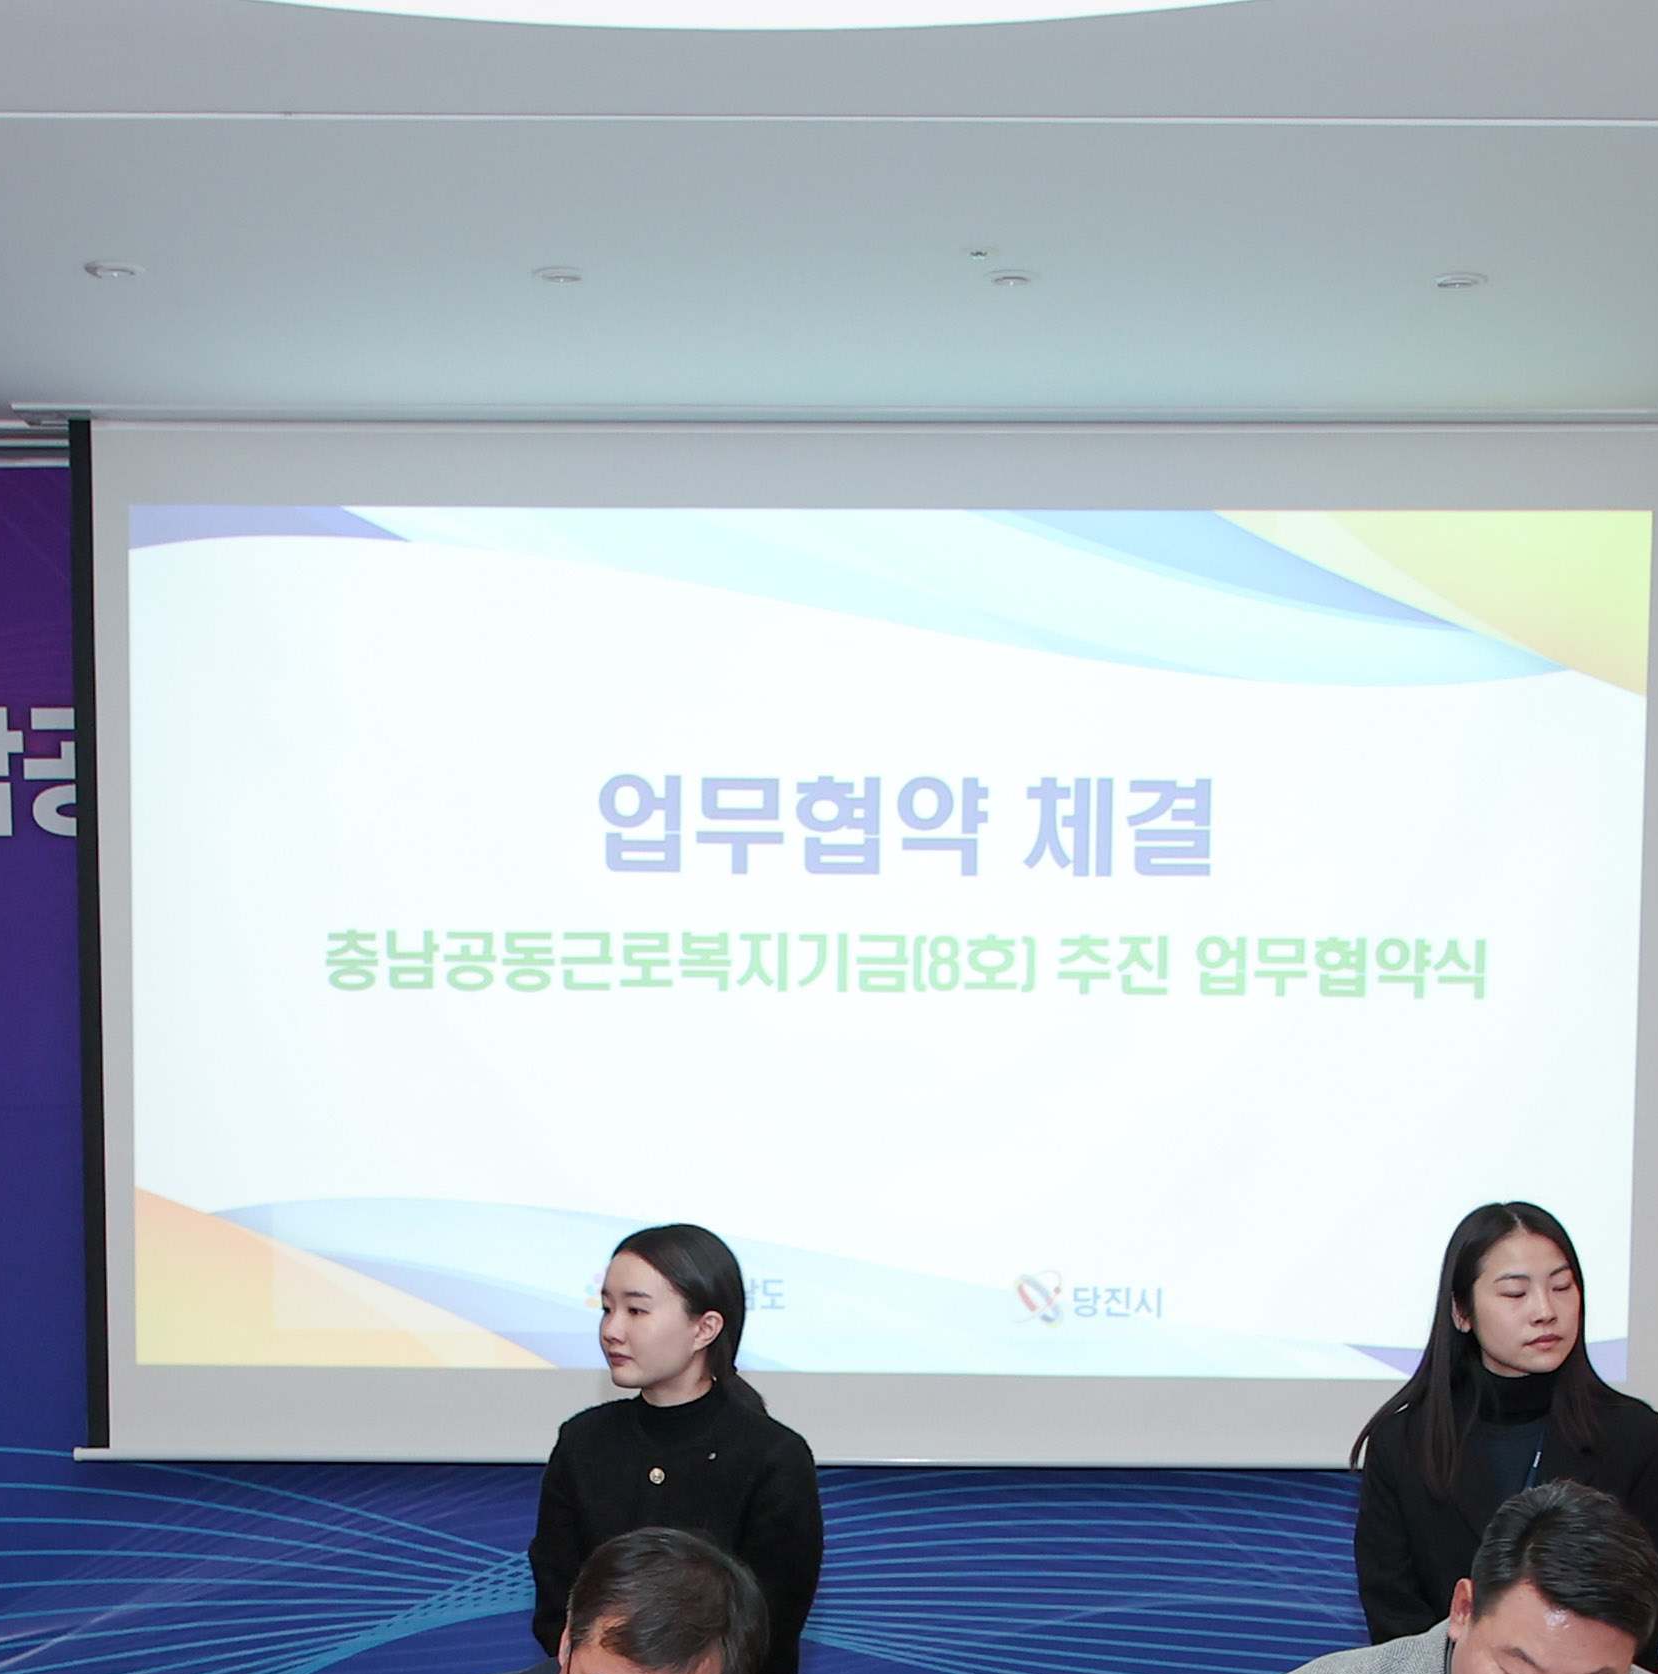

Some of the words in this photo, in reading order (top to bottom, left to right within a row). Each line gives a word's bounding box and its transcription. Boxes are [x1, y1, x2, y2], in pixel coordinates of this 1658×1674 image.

[596, 772, 989, 877] 업무협약
[1023, 776, 1215, 878] 체결
[1055, 933, 1171, 997] 추진
[1196, 935, 1489, 1000] 업무협약식
[1072, 1286, 1163, 1318] 당진시
